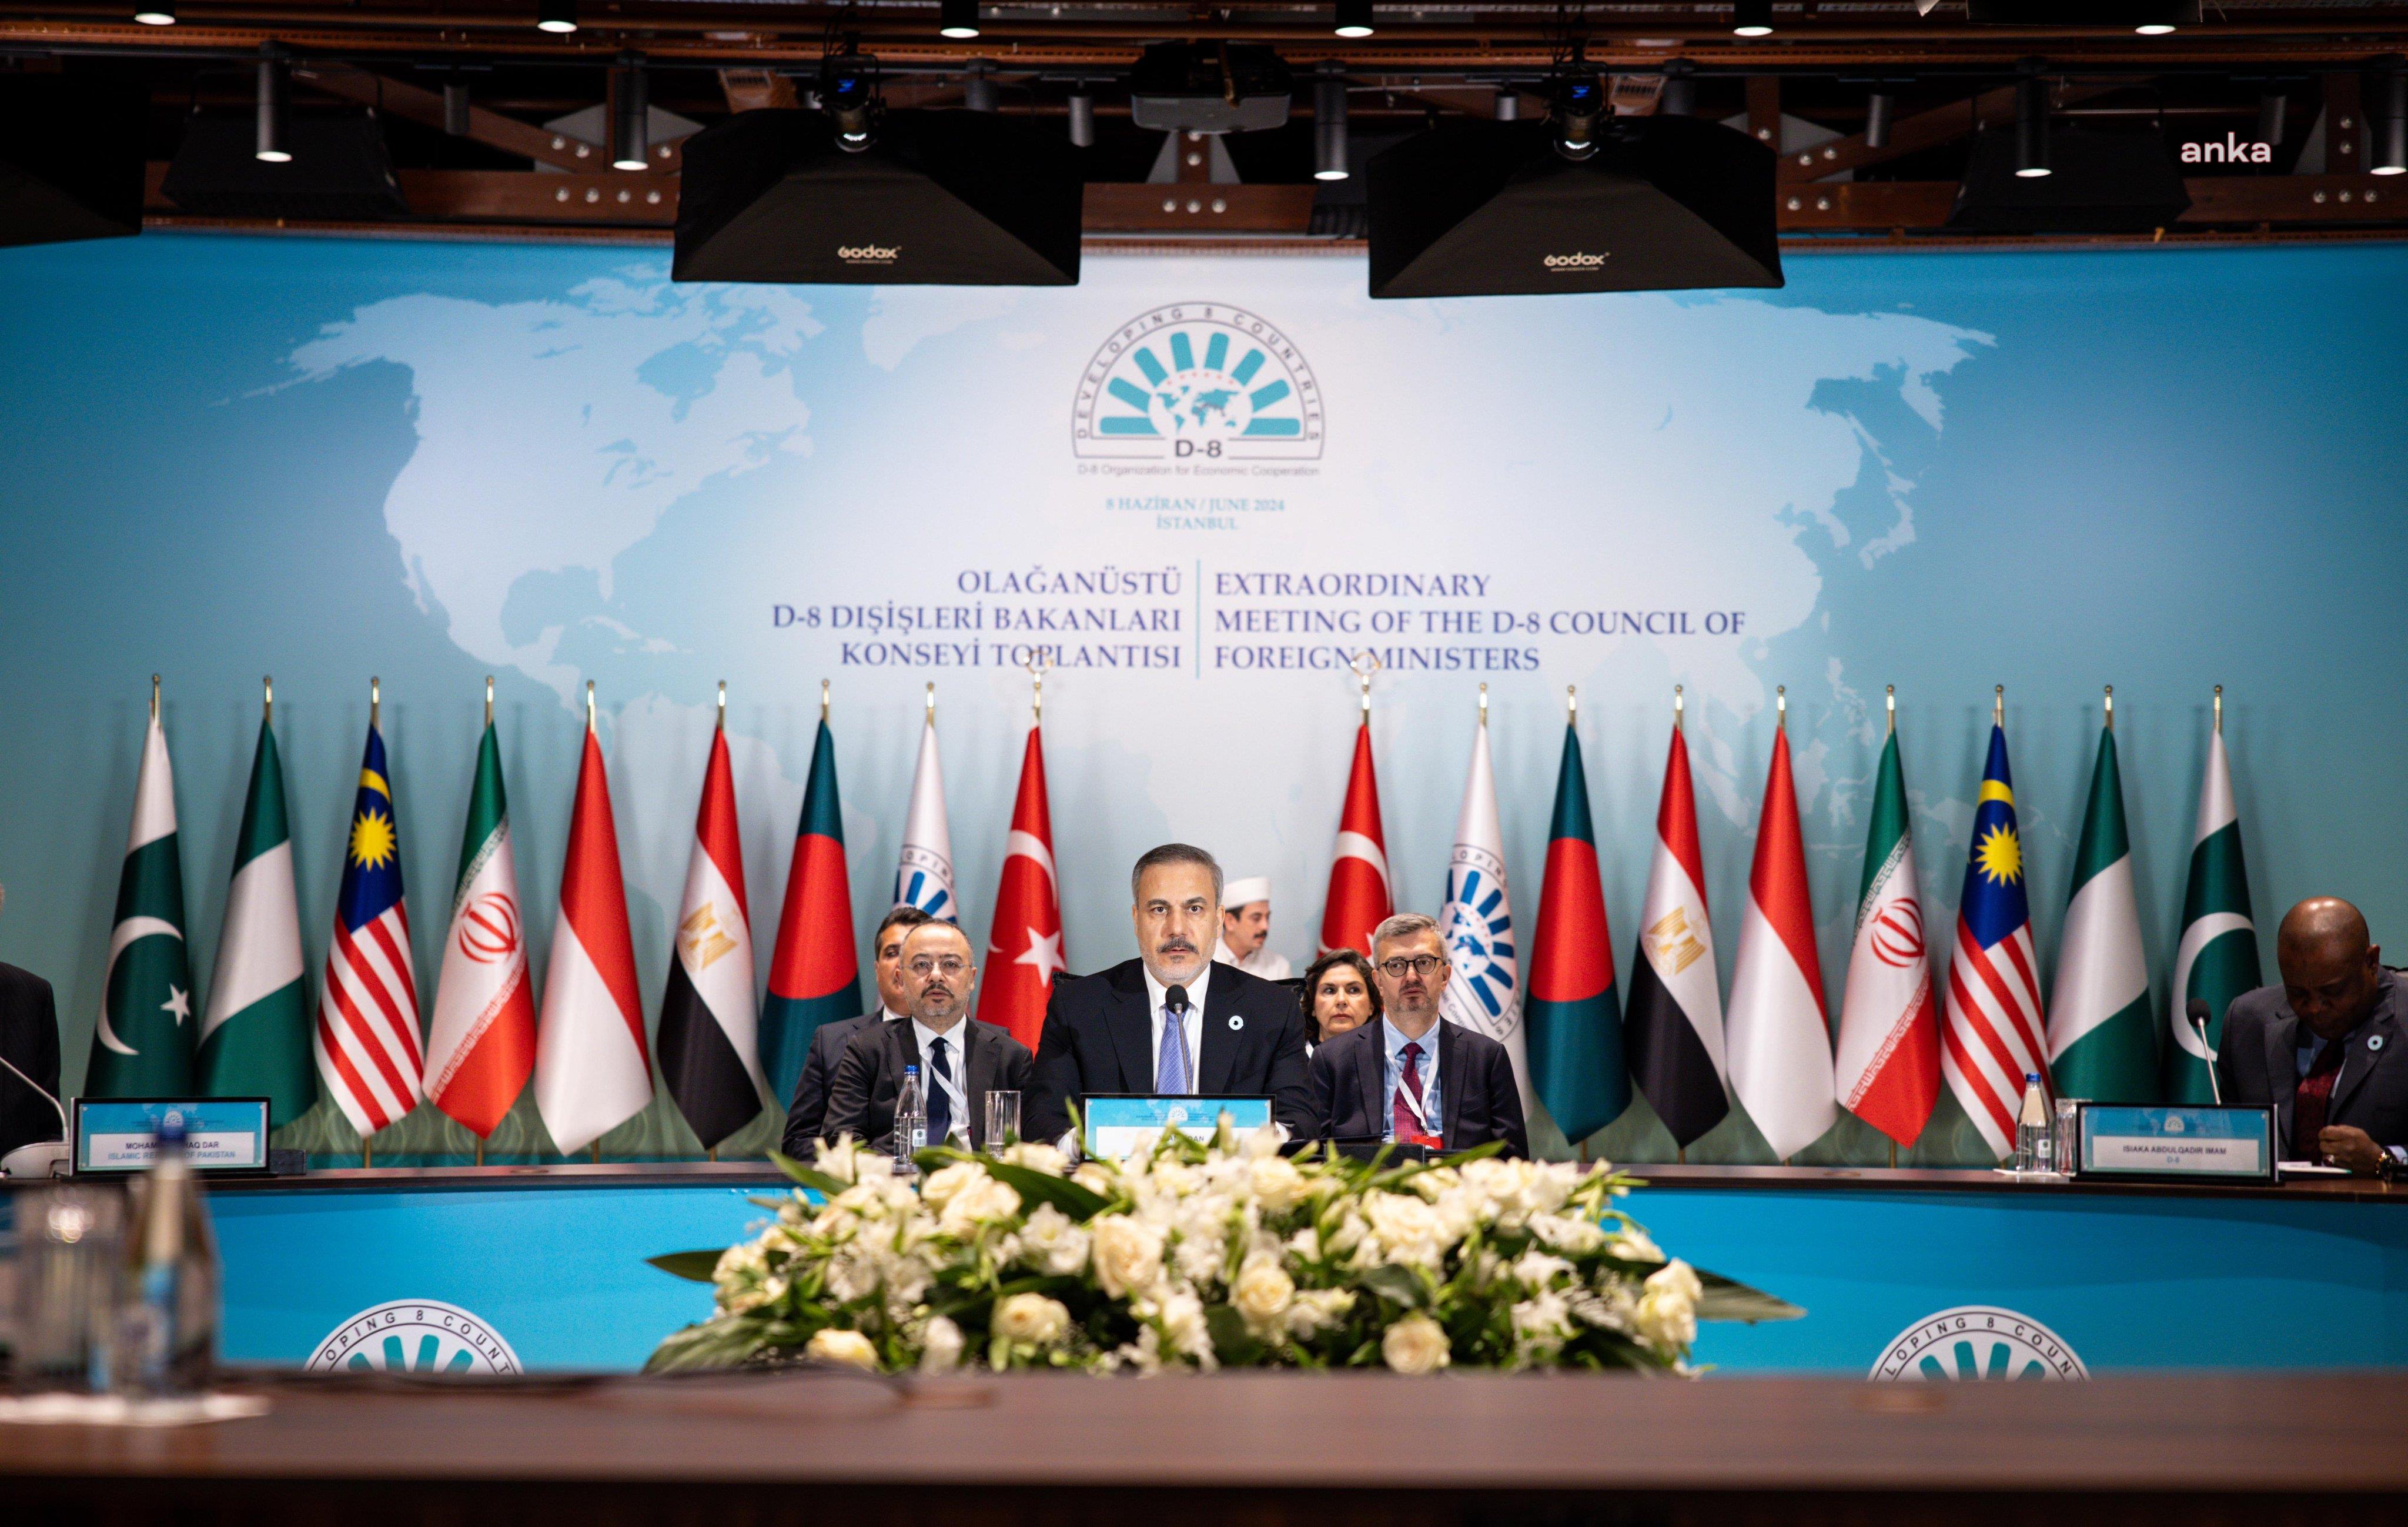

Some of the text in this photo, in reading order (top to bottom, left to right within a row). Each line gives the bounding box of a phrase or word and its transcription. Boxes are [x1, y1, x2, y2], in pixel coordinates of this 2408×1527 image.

[837, 244, 898, 259] Godox
[1544, 251, 1606, 266] Godox
[1077, 307, 1320, 440] DEVELOPING 8 COUNTRIES
[1175, 440, 1222, 458] D-8
[1077, 464, 1319, 477] D-8 Organization for Economic Cooperation
[1106, 499, 1114, 510] 8
[1118, 496, 1196, 511] HAZİRAN
[1209, 498, 1248, 513] JUNE
[1254, 499, 1285, 511] 2024
[1156, 514, 1238, 530] İSTANBUL
[958, 566, 1181, 595] OLAĞANÜSTÜ
[1215, 573, 1490, 597] EXTRAORDINARY
[773, 600, 1181, 634] D-8 DIŞİŞLERİ BAKANLARI
[1215, 609, 1745, 635] MEETING OF THE D-8 COUNCIL OF
[841, 638, 1181, 668] KONSEYİ TOPLANTISI
[1215, 647, 1540, 671] FOREIGN MINISTERS
[324, 1310, 510, 1374] OPING 8 COUNT
[1884, 1317, 2072, 1376] LOPING 8 COUN
